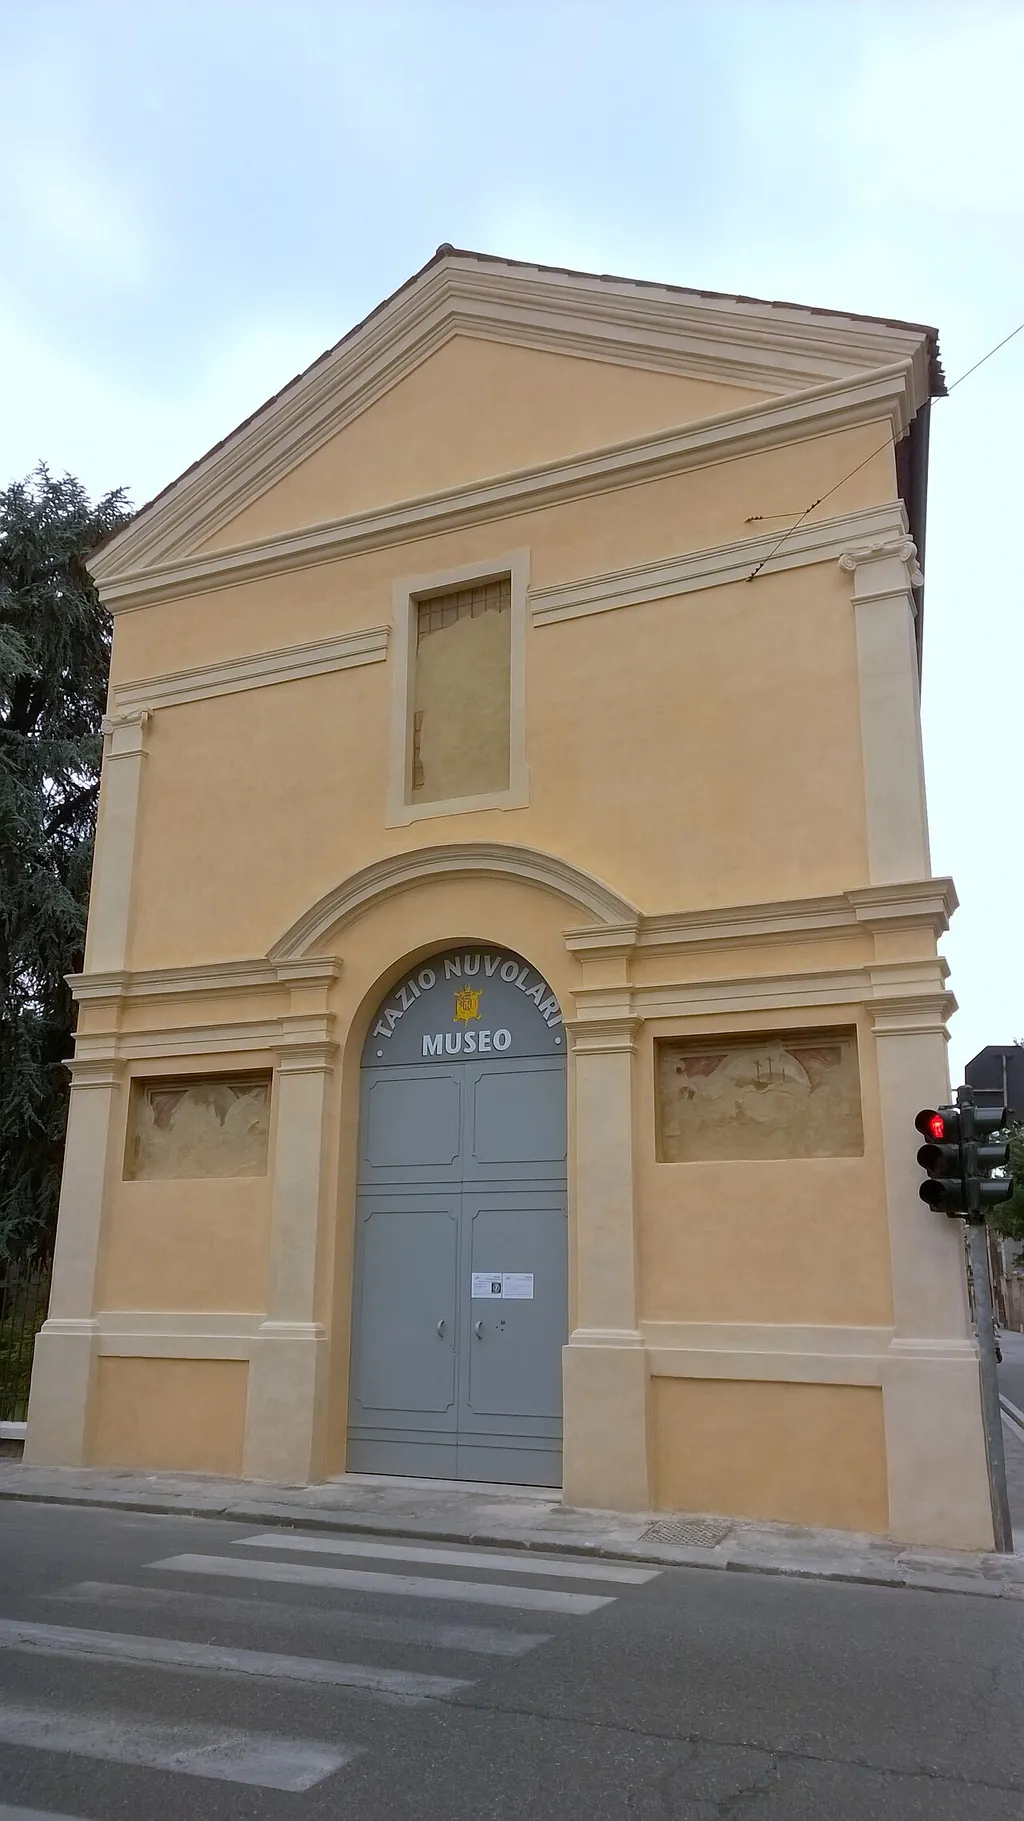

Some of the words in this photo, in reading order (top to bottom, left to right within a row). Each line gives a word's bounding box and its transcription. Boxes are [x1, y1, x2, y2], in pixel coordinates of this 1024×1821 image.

[372, 968, 437, 1039] TAZIO
[443, 955, 563, 1028] NUVOLARI
[422, 1028, 512, 1056] MUSEO
